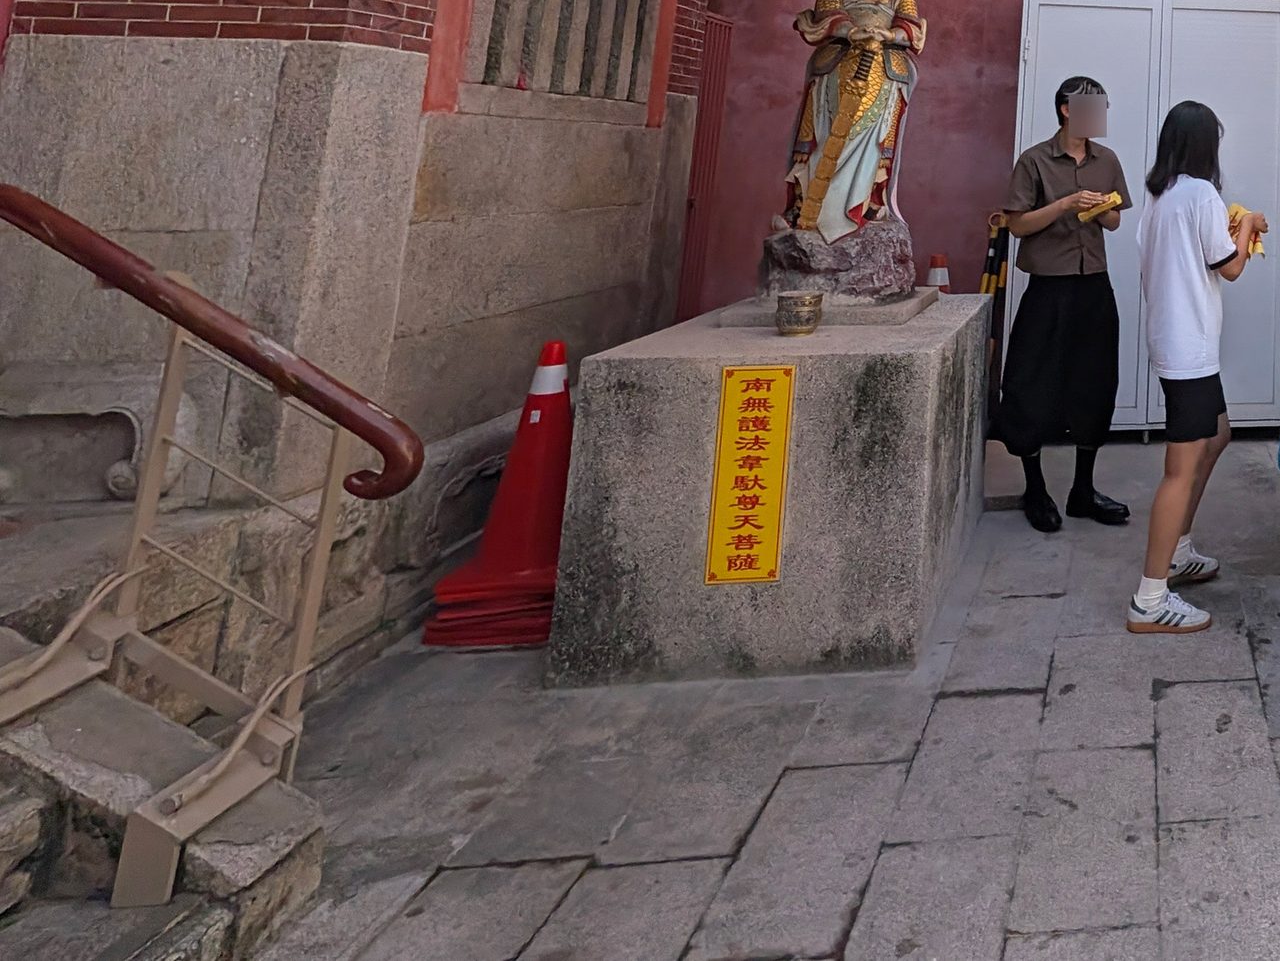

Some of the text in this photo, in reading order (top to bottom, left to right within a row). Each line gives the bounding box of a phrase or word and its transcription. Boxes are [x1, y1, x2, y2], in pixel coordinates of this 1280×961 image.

[726, 377, 777, 572] 南無護法韋馱尊天菩薩
